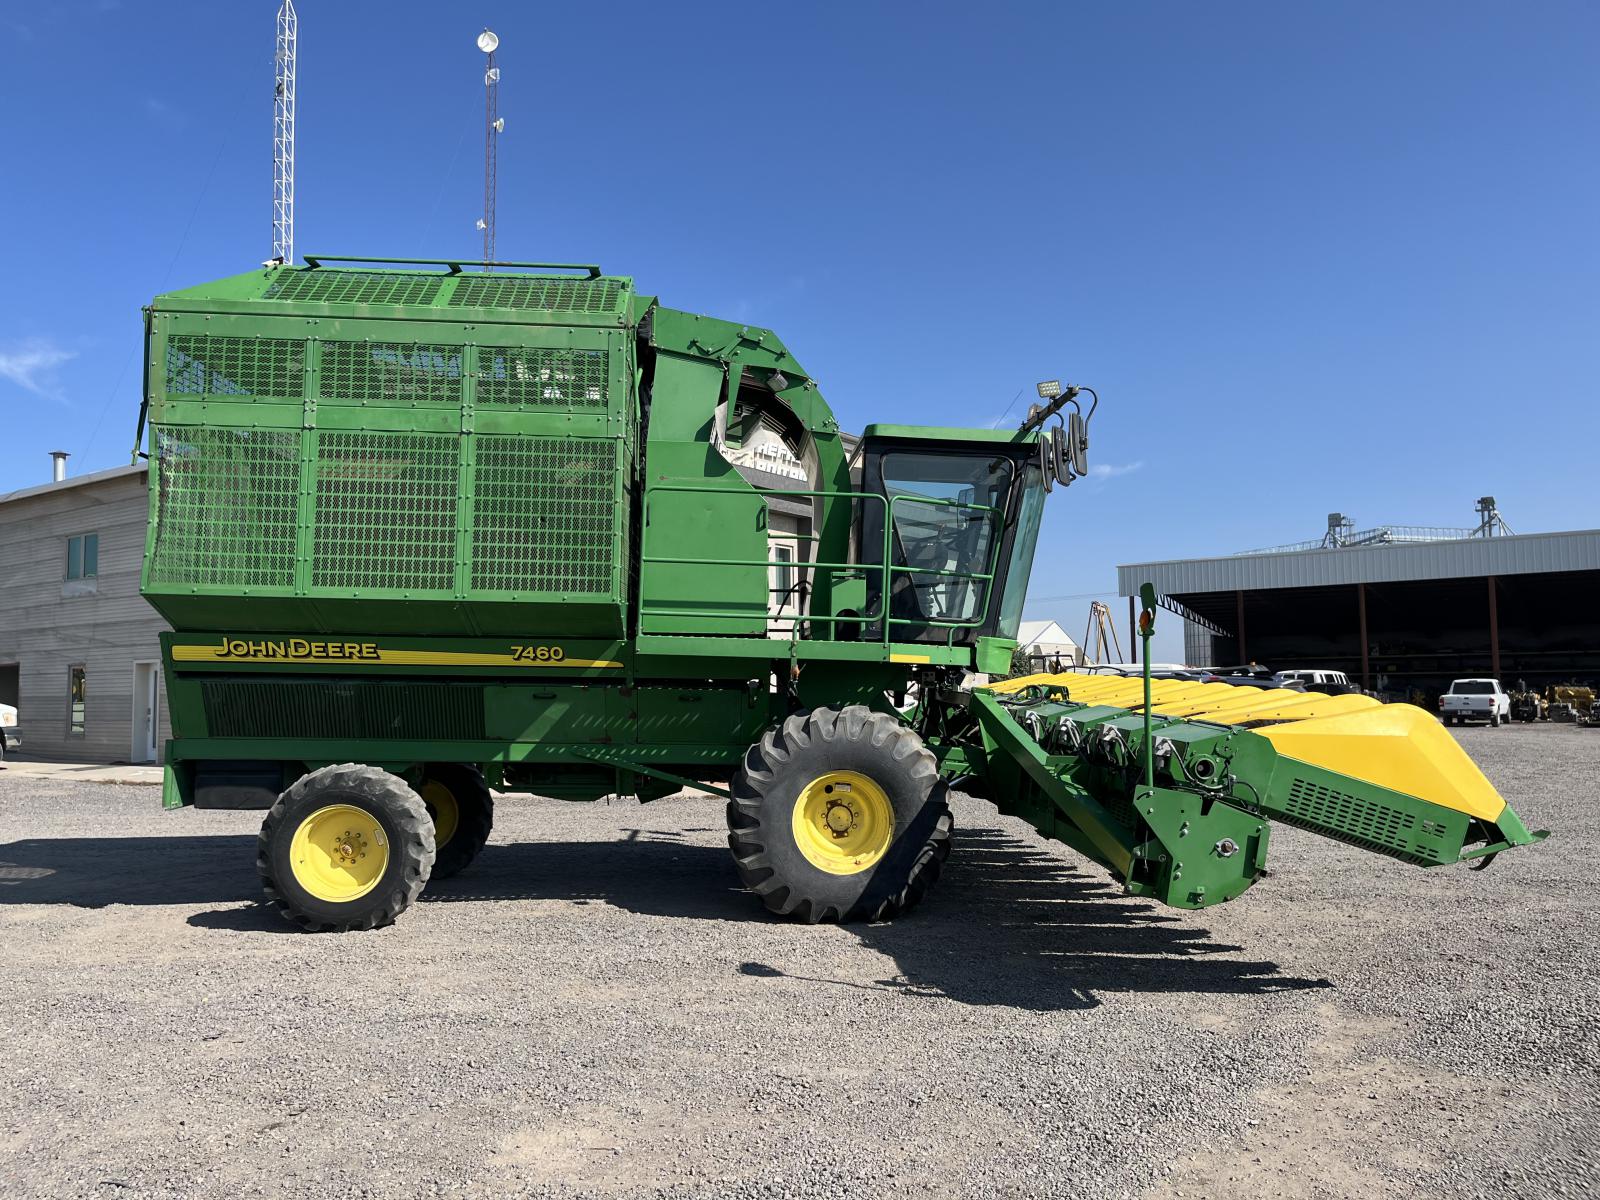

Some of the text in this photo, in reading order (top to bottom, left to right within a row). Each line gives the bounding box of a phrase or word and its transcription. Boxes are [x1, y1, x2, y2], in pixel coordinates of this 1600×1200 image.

[215, 637, 379, 659] JOHN DEERE
[510, 646, 564, 661] 7460
